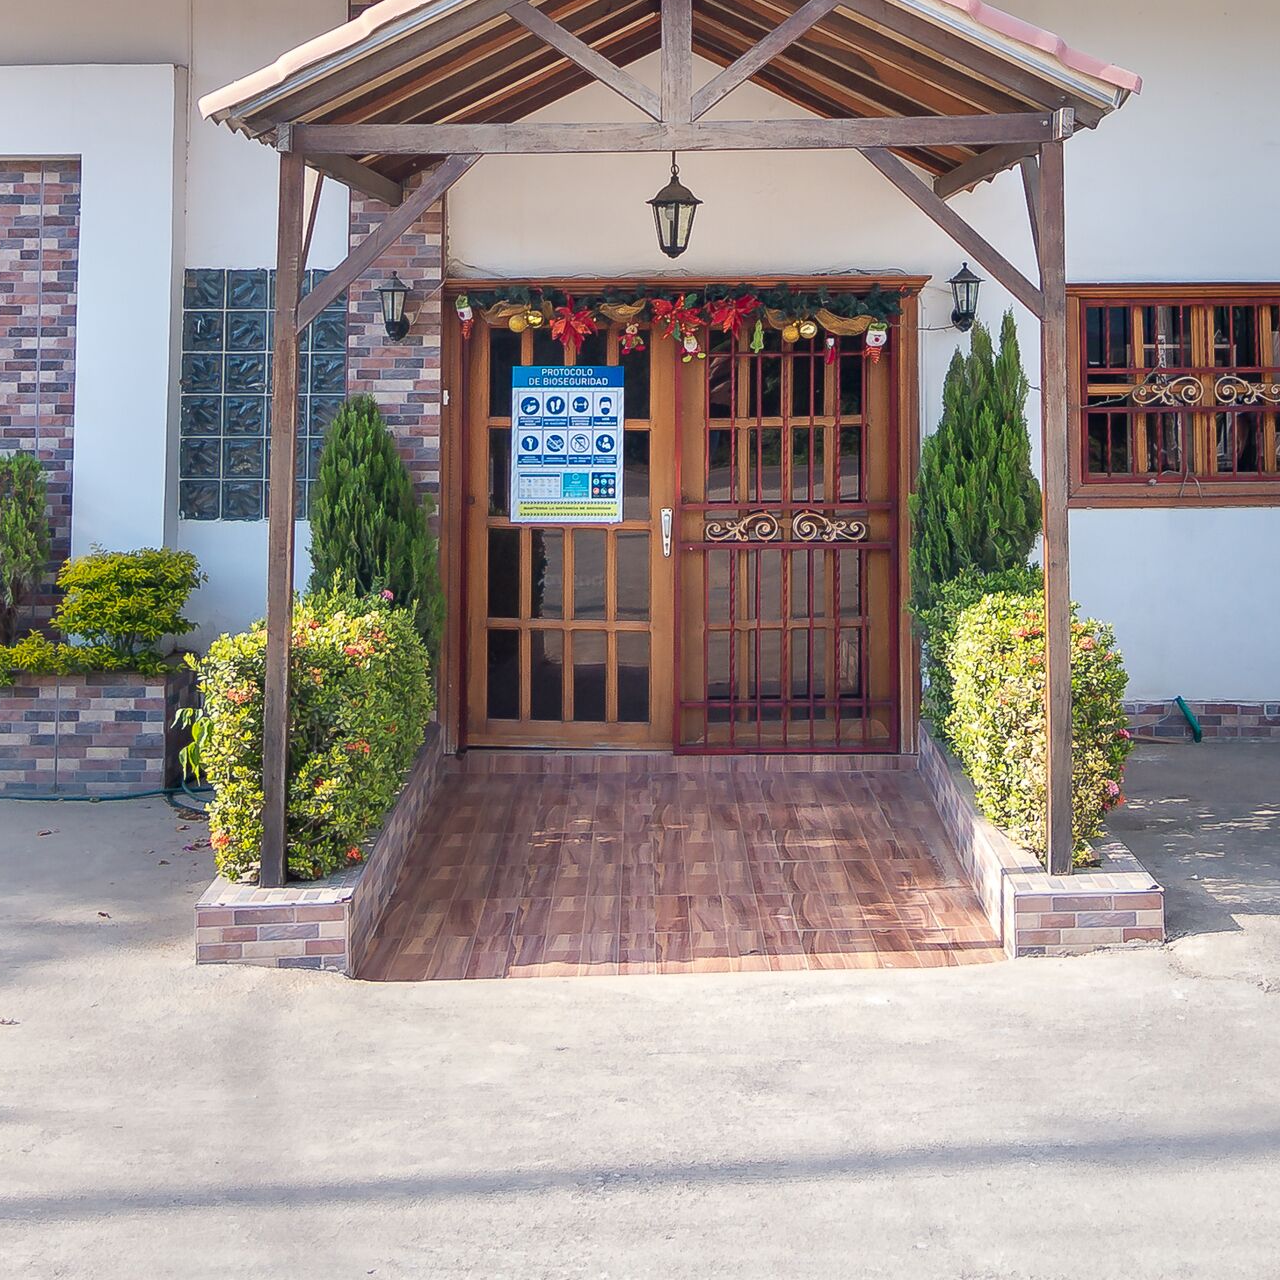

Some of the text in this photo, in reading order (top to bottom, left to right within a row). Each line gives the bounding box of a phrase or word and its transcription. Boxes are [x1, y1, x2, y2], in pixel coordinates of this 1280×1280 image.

[541, 368, 594, 377] PROTOCOLO
[528, 378, 609, 386] DE BIOSEGURIDAD
